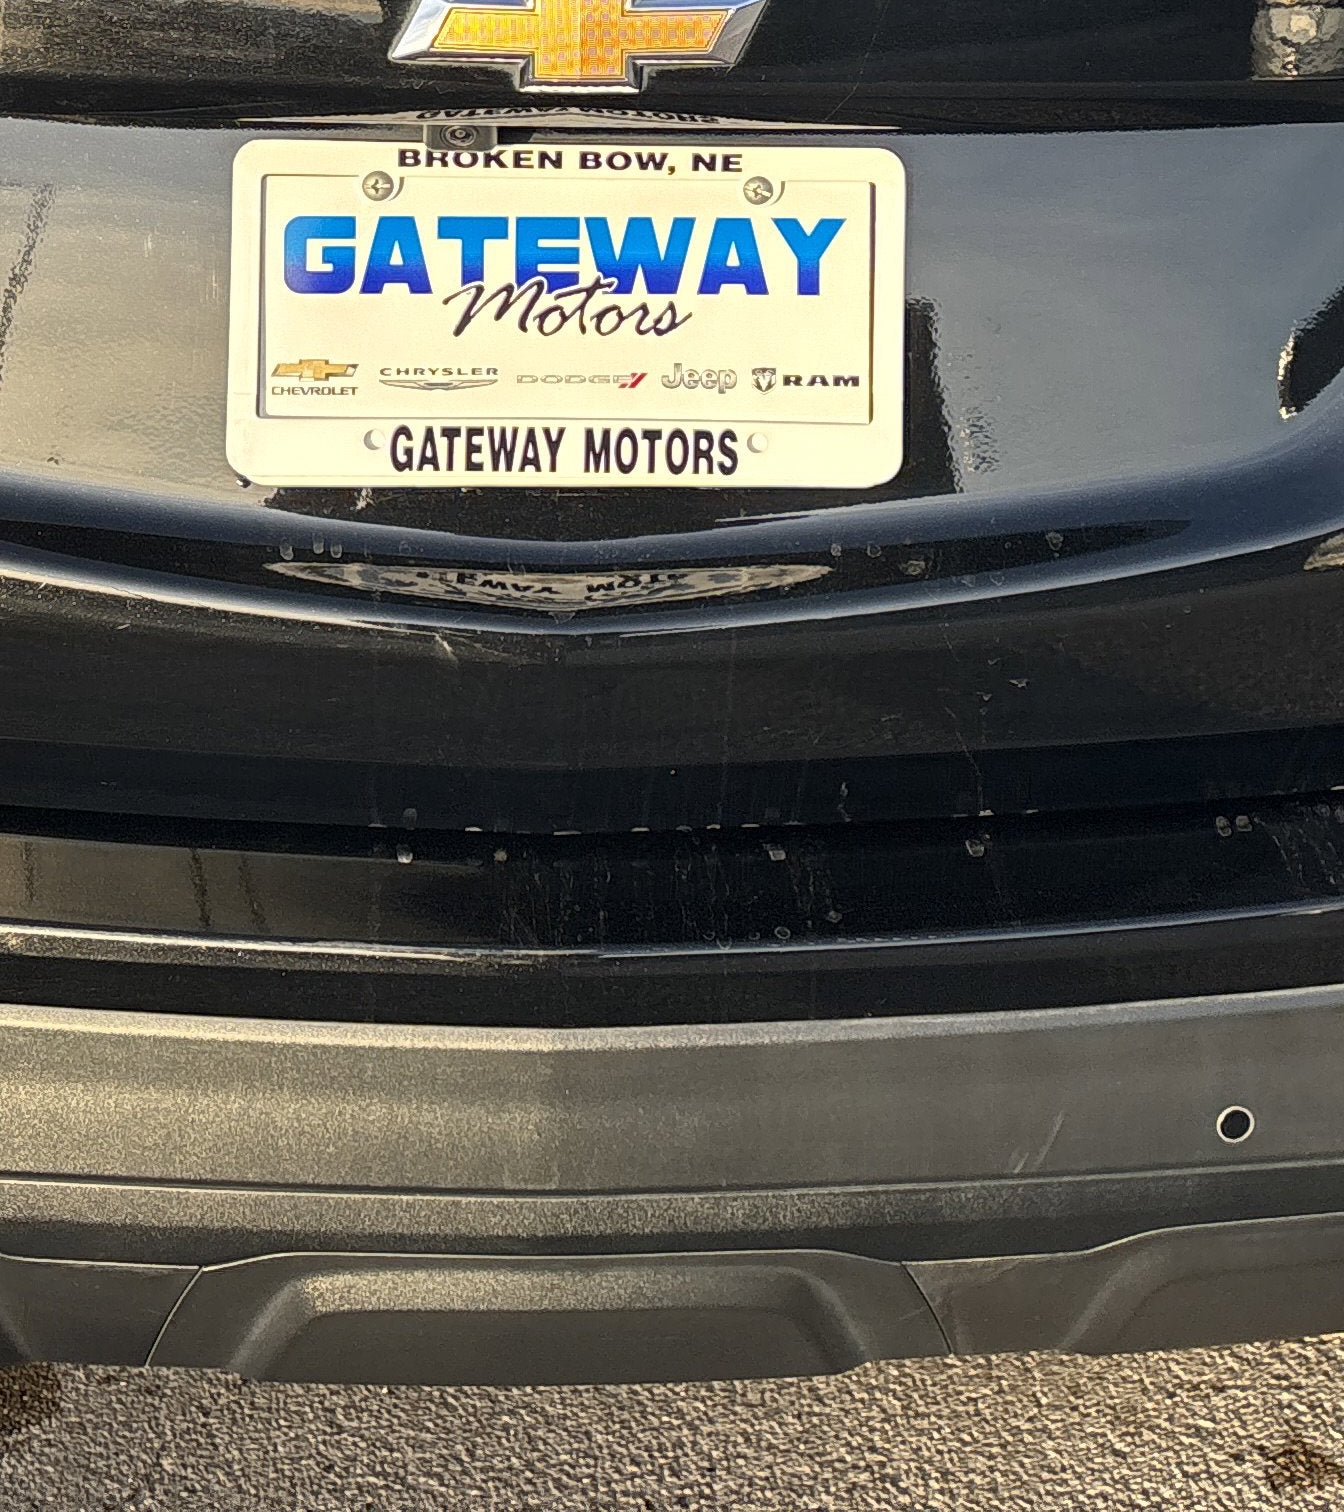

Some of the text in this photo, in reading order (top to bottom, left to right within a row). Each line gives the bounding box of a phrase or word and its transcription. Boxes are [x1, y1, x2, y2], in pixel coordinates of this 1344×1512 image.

[397, 149, 743, 175] BROKEN BOW, NE
[283, 215, 847, 296] GATEWAY
[442, 275, 692, 337] Motors
[271, 363, 860, 396] CHEVROLET CHRYSLER DODGE Jeep RAM
[390, 425, 739, 476] GATEWAY MOTORS
